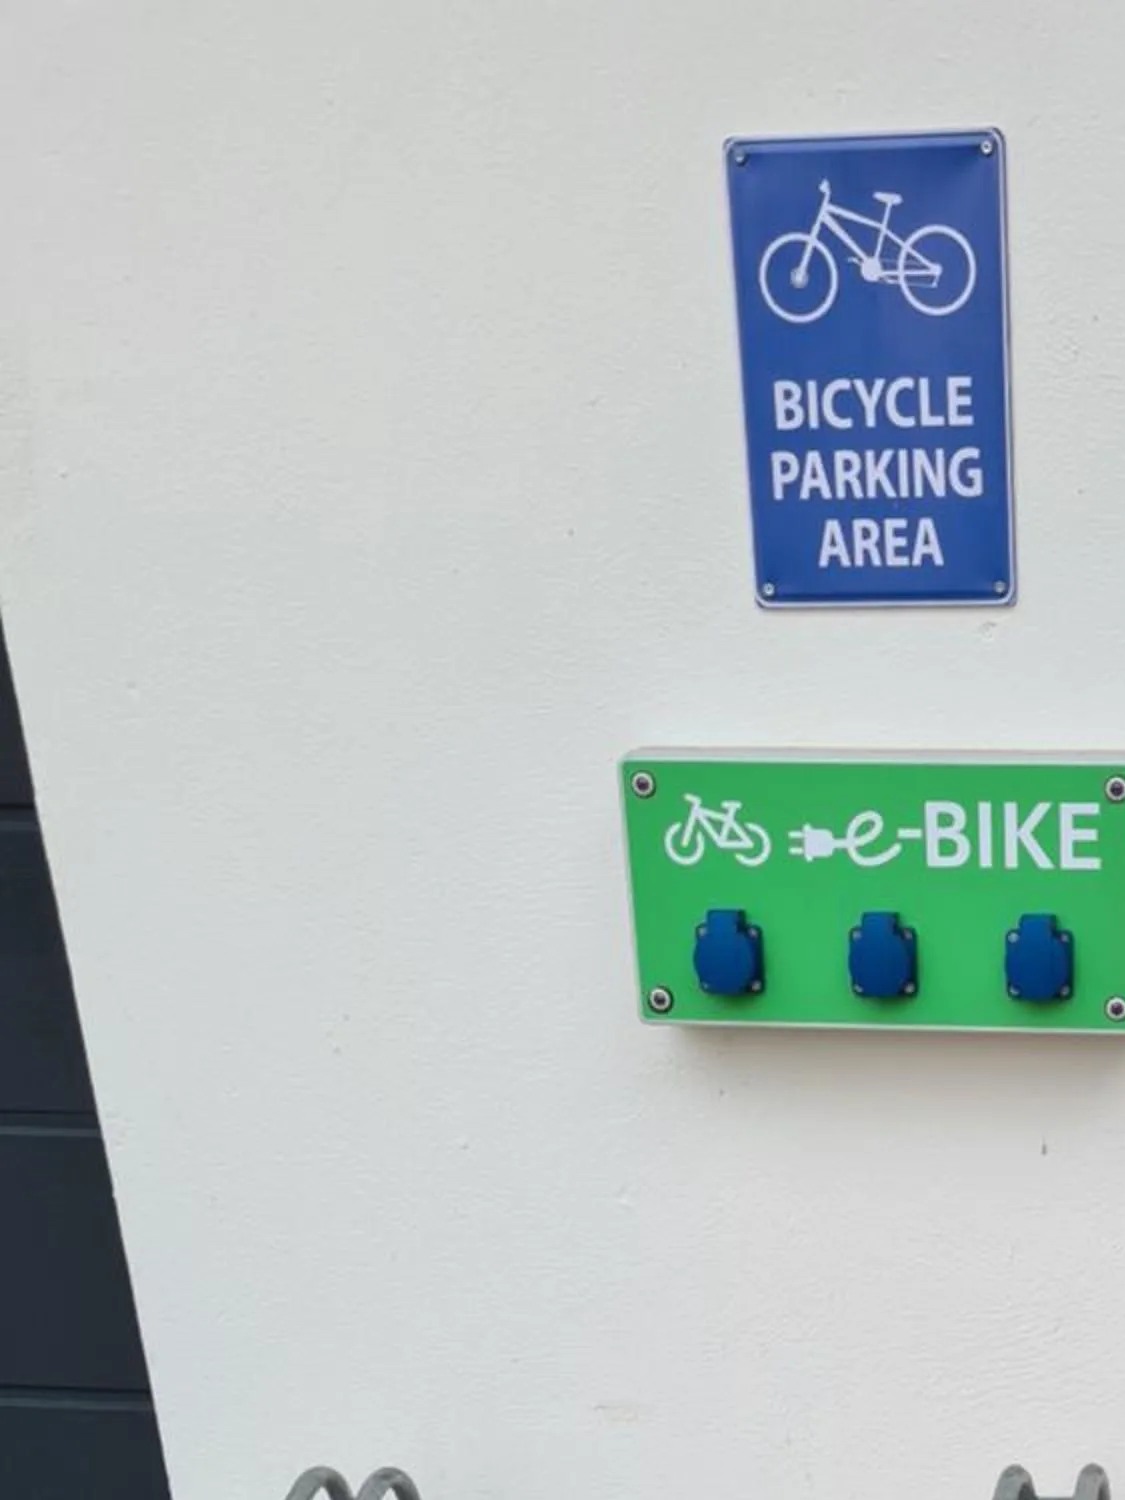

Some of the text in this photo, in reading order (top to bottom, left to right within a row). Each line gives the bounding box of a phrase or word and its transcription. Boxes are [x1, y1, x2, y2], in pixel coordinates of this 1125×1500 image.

[772, 376, 974, 431] BICYCLE
[770, 447, 985, 500] PARKING
[818, 518, 945, 568] AREA
[846, 800, 1103, 870] e-BIKE
